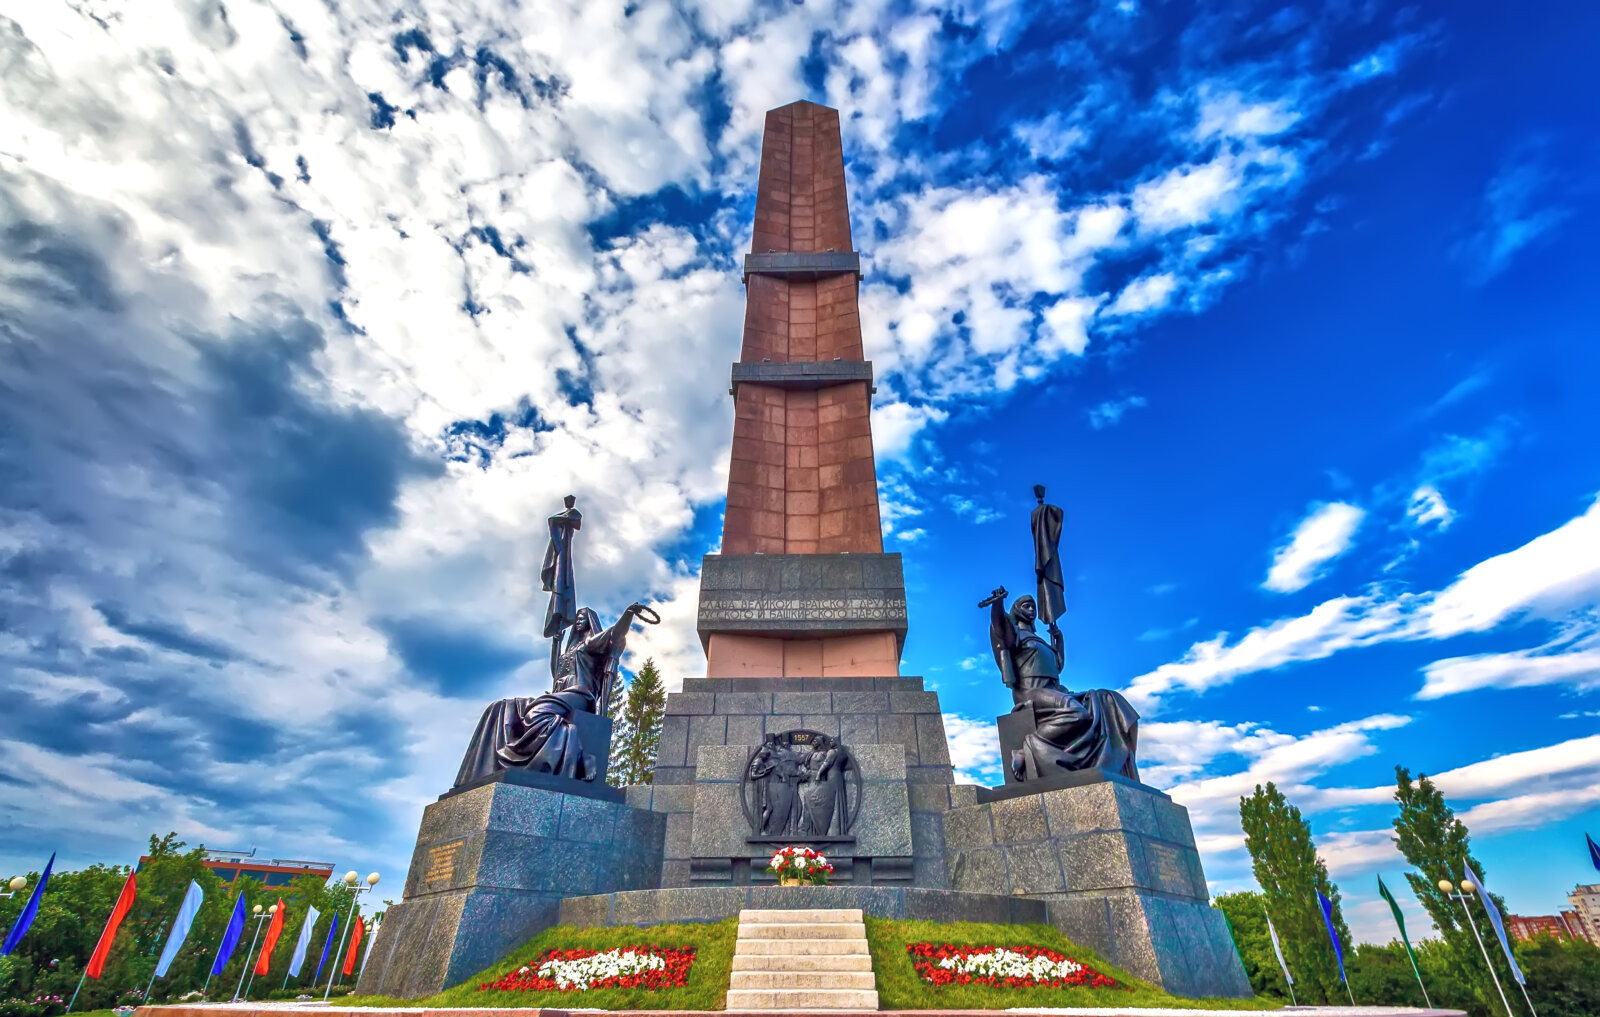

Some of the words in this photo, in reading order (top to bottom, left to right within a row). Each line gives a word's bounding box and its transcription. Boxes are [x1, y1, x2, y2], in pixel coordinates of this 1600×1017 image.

[741, 600, 792, 610] ВЕЛИКОЙ
[800, 600, 854, 609] БРАТСКОЙ
[698, 610, 753, 619] РУССКОГО
[757, 610, 765, 619] И
[770, 609, 846, 619] БАШКИРСКОГО
